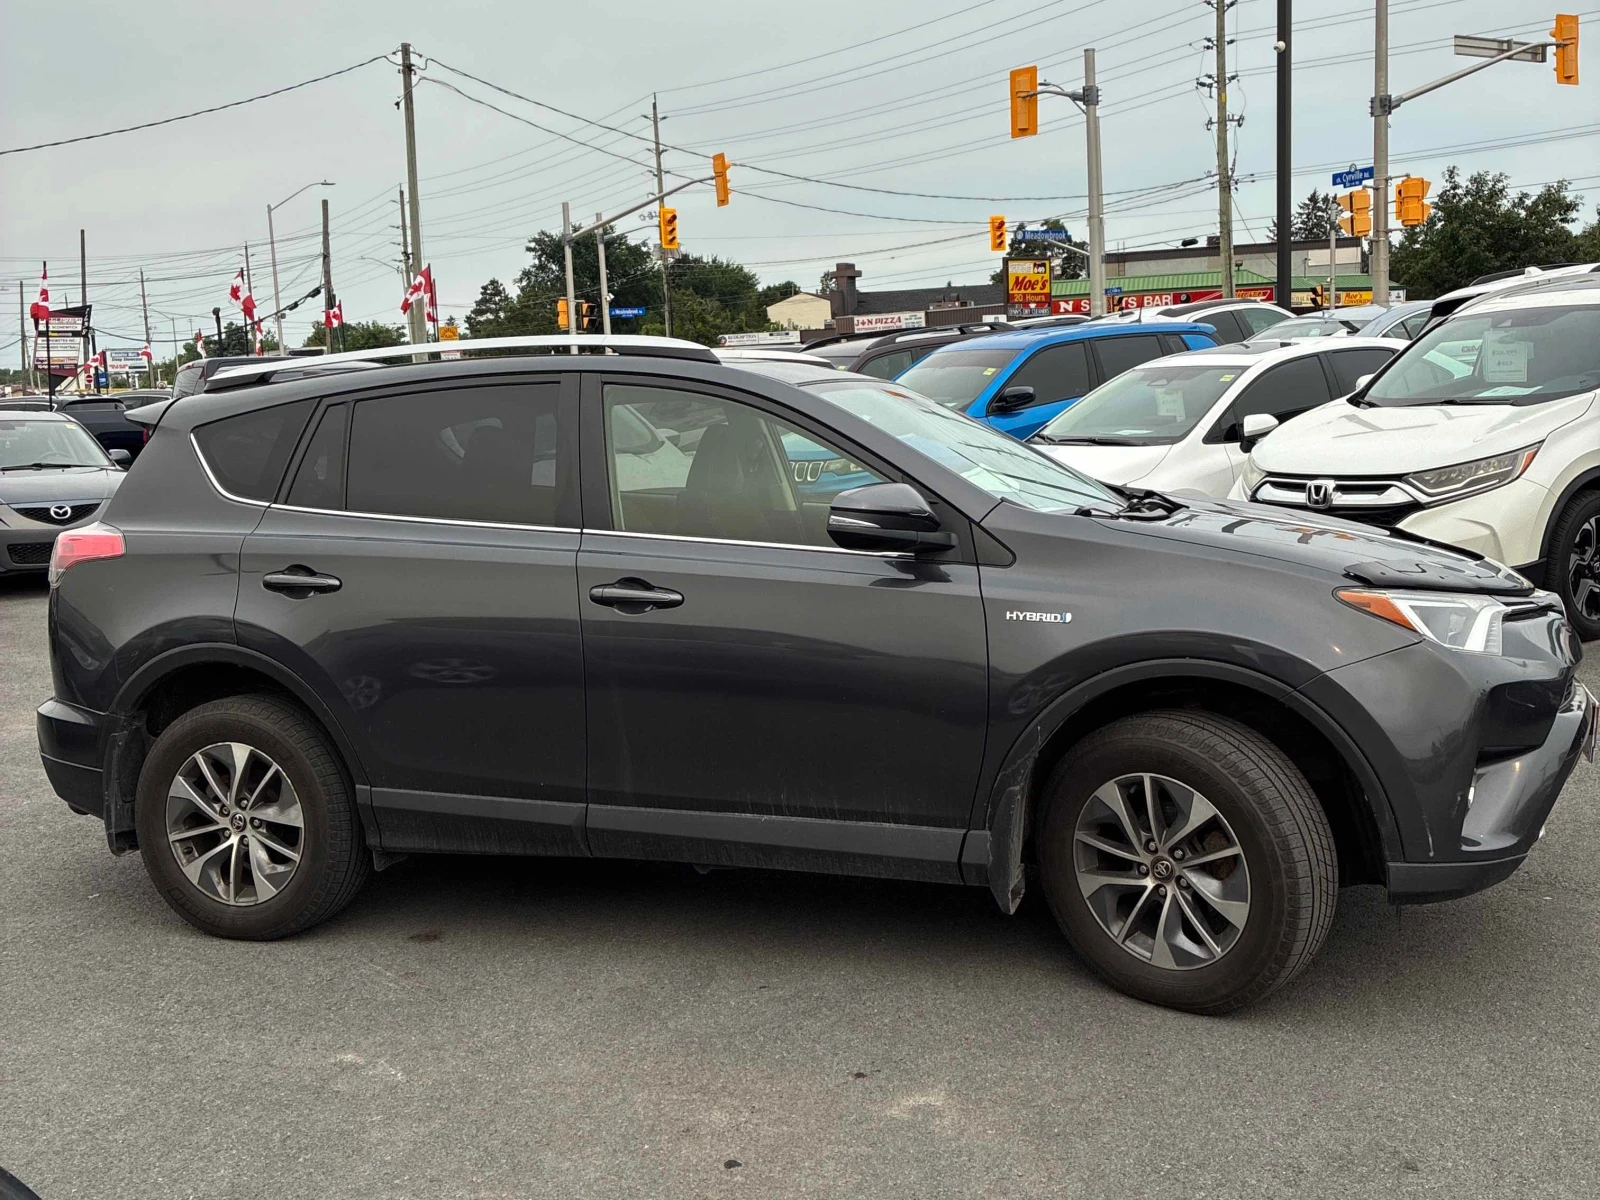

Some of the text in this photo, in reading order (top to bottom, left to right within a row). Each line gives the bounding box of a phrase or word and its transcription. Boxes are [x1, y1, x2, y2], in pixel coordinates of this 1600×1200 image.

[1342, 170, 1363, 186] Cyrville
[1024, 230, 1066, 240] Meadowbrook
[1010, 275, 1049, 292] Moe's
[1014, 293, 1046, 302] 20 Hours
[1143, 294, 1171, 307] BAR
[874, 315, 902, 325] PIZZA
[1005, 610, 1062, 623] HYBRID
